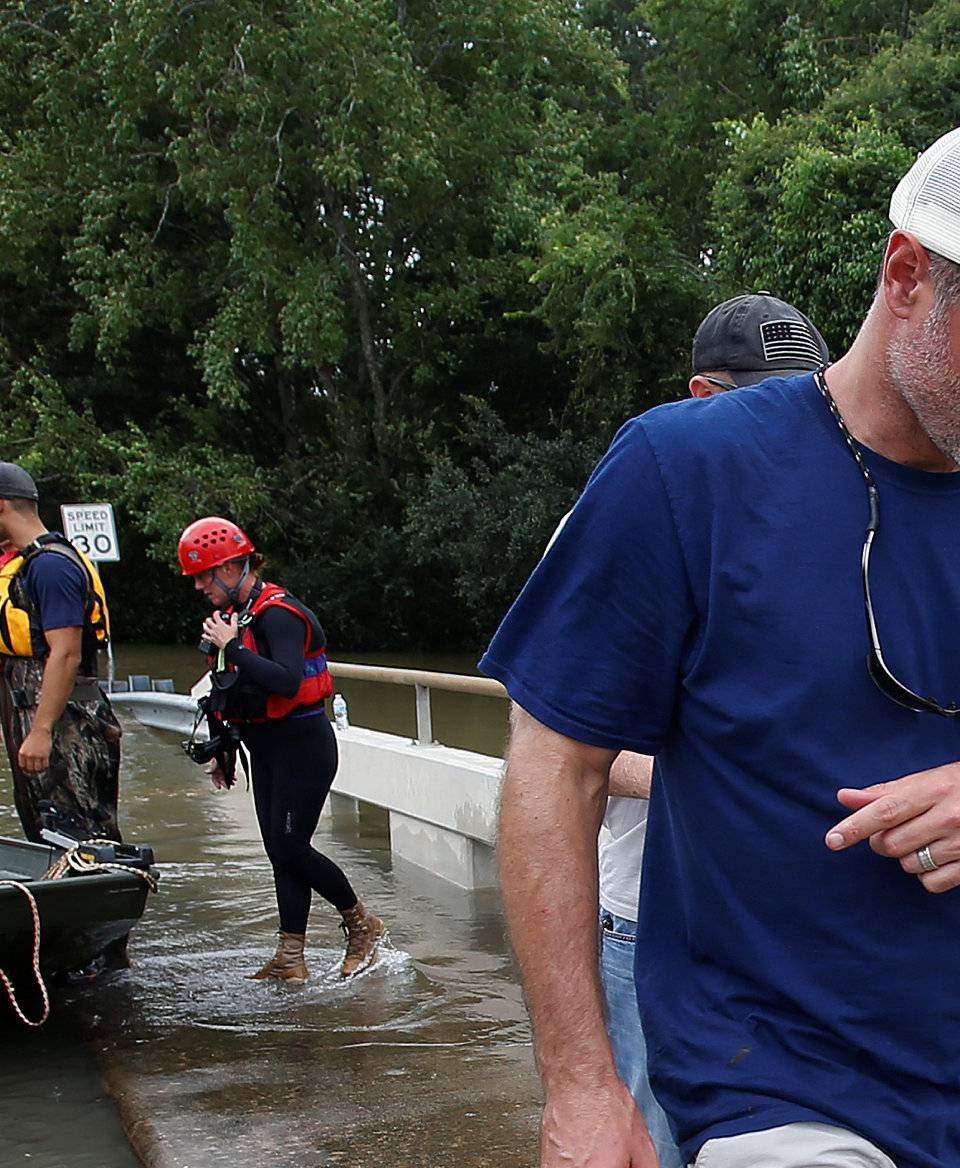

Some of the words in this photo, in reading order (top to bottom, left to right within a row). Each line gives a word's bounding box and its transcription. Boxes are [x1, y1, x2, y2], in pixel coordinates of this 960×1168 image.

[67, 510, 108, 521] SPEED
[73, 522, 105, 532] LIMIT
[71, 534, 112, 554] 30
